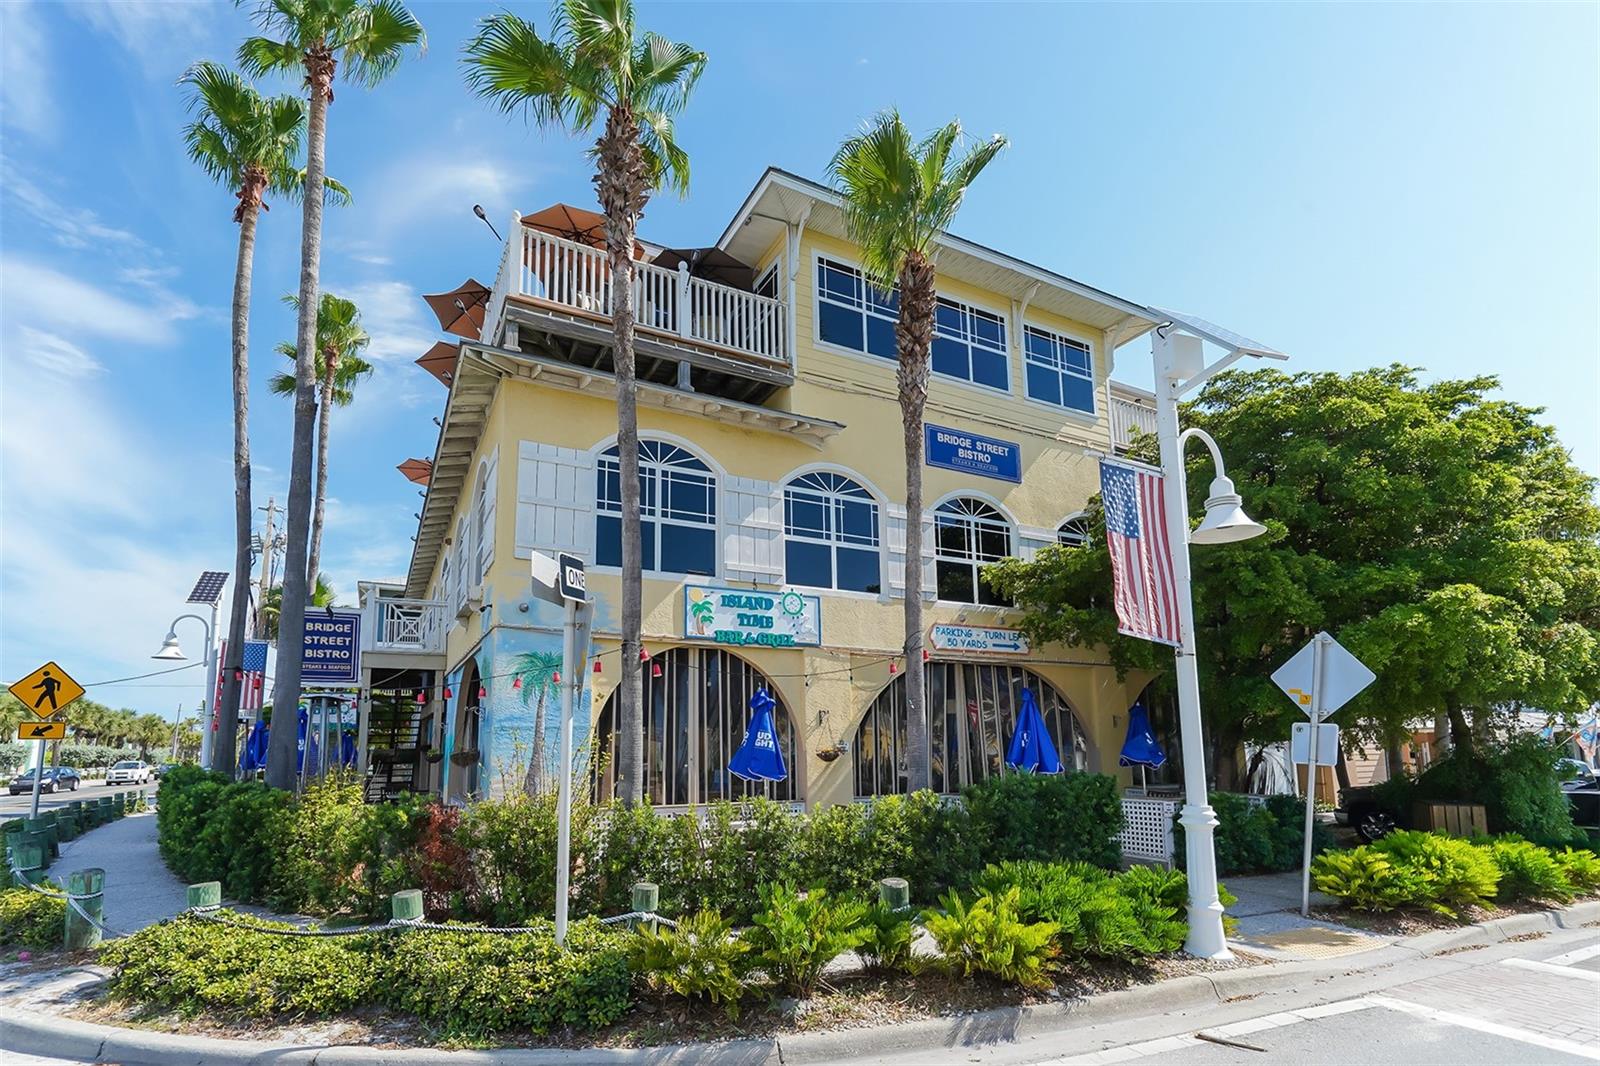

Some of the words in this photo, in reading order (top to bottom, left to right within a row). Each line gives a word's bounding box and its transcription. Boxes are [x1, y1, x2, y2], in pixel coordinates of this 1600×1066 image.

[936, 432, 972, 449] BRIDGE
[975, 441, 1009, 457] STREET
[958, 448, 991, 463] BISTRO
[720, 594, 774, 611] ISLAND
[737, 613, 774, 629] TIME
[305, 622, 352, 633] BRIDGE
[935, 627, 973, 638] PARKING
[983, 630, 1006, 640] TURN
[304, 635, 352, 646] STREET
[714, 629, 745, 646] BAR
[745, 631, 755, 644] &
[756, 632, 795, 648] GRILL
[947, 638, 958, 647] 50
[960, 639, 988, 649] YARDS
[304, 649, 350, 659] BISTRO
[757, 731, 772, 740] UD
[754, 739, 775, 749] GHT
